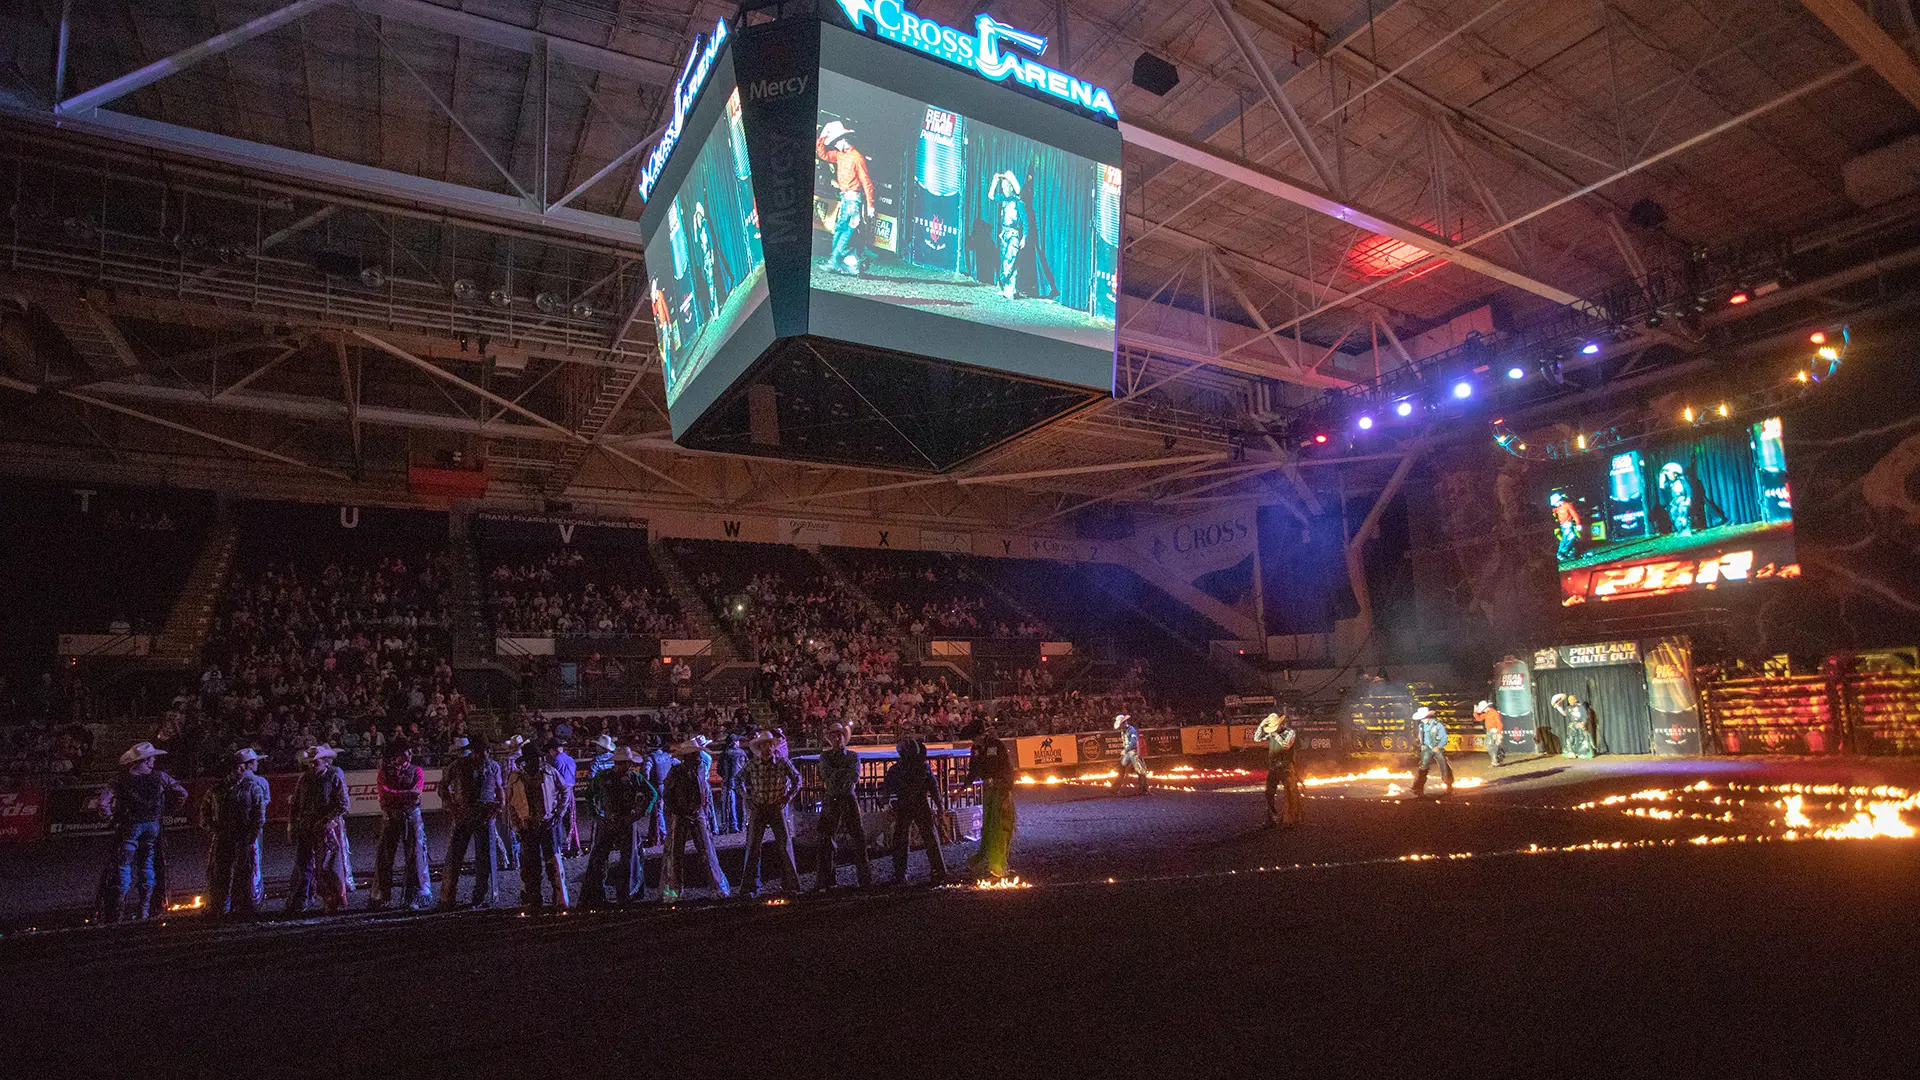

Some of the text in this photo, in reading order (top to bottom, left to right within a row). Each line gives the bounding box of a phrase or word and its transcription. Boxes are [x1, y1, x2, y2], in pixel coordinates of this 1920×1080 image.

[874, 0, 975, 59] CROSS
[879, 26, 973, 67] INSURANCE
[748, 75, 809, 101] Mercy
[1003, 57, 1115, 115] ARENA
[926, 108, 952, 123] REAL
[925, 120, 953, 137] TIME
[73, 489, 98, 513] T
[339, 507, 359, 528] U
[479, 512, 510, 521] FRANK
[549, 516, 597, 528] MEMORIAL
[598, 520, 628, 529] PRESS
[629, 521, 648, 530] BOX
[558, 525, 575, 544] V
[723, 521, 741, 537] W
[1172, 517, 1248, 554] CROSS
[879, 530, 889, 547] X
[1002, 540, 1011, 555] Y
[1569, 643, 1636, 656] PORTLAND
[1570, 653, 1607, 665] CHUTE
[1609, 651, 1635, 662] OUT
[1502, 673, 1523, 681] REAL
[1034, 749, 1062, 759] MATADOR
